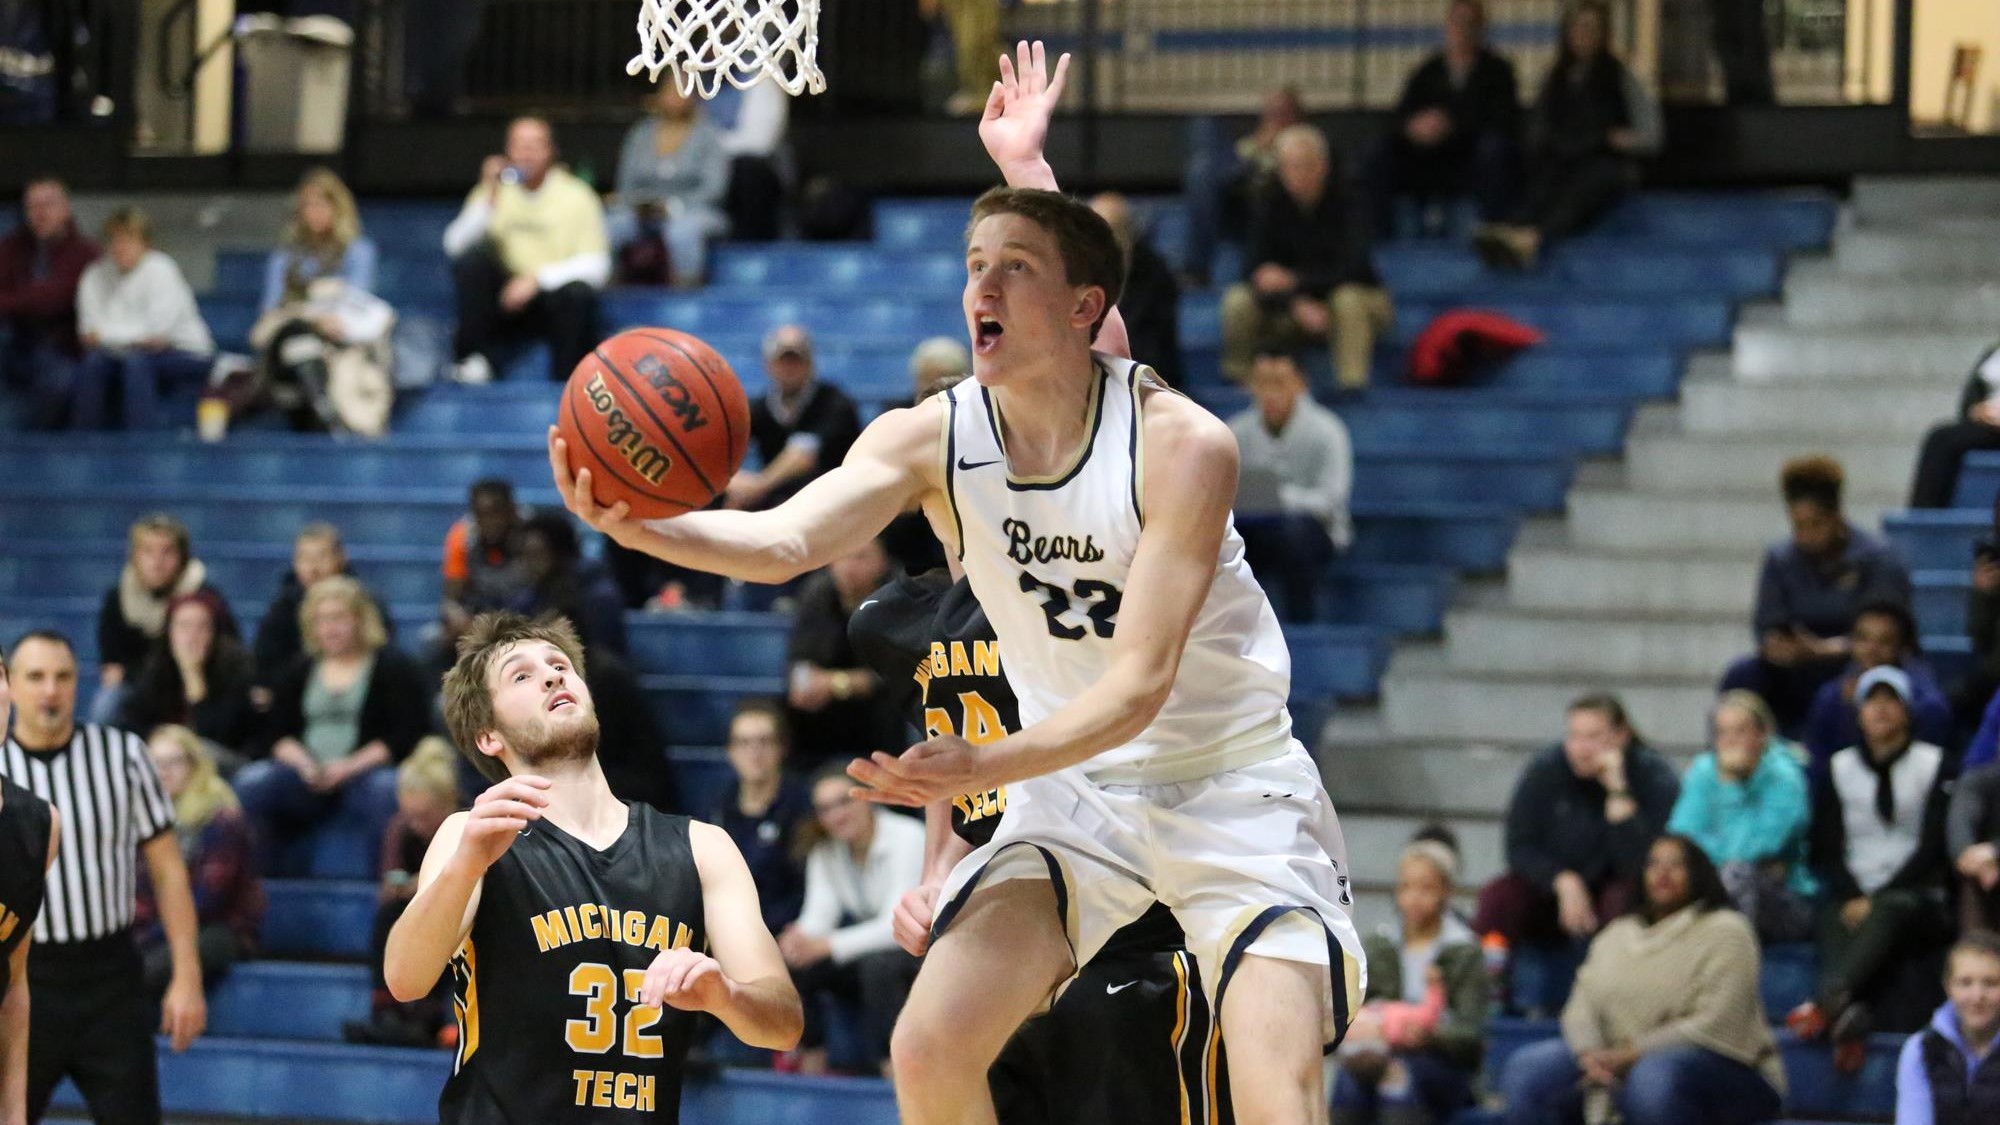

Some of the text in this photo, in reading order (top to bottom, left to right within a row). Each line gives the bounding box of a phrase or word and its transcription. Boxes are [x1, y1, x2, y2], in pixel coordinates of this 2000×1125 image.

[584, 370, 673, 487] Wilson
[635, 354, 708, 432] NCAA
[1002, 517, 1104, 565] Bears
[1018, 570, 1123, 640] 22
[564, 962, 665, 1059] 32
[573, 1069, 656, 1112] TECH
